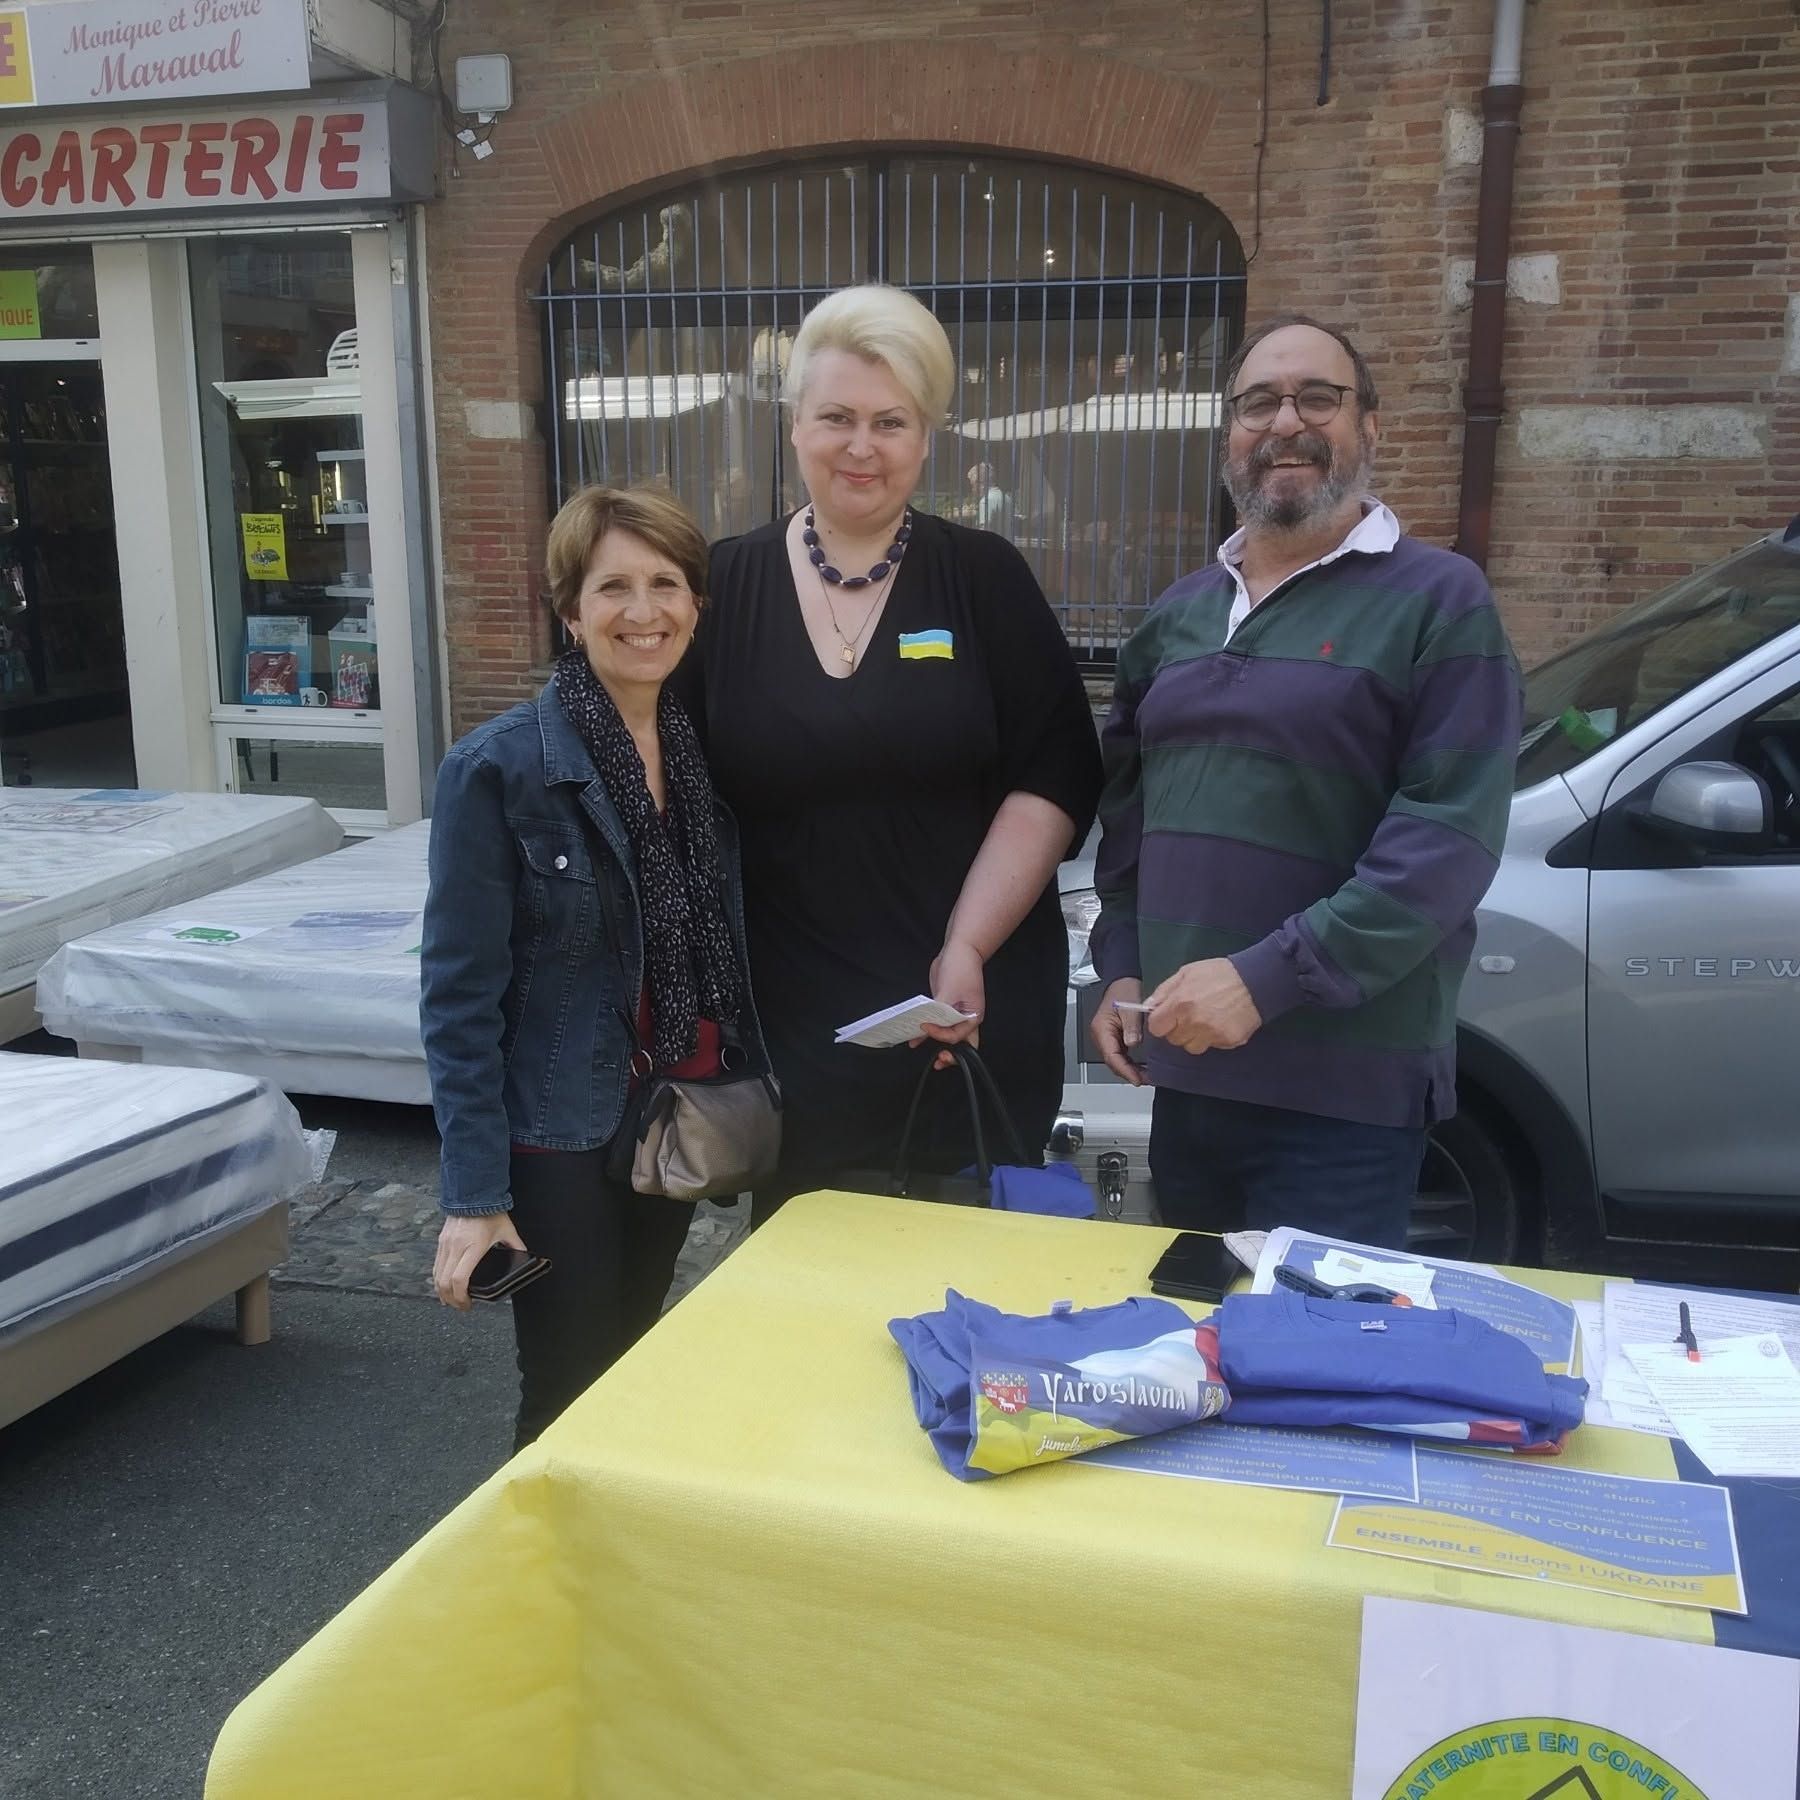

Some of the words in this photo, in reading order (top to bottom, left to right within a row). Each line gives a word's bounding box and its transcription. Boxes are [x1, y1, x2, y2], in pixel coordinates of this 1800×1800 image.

[63, 21, 162, 54] Monique
[168, 8, 187, 33] et
[193, 0, 263, 28] Pierre
[90, 29, 244, 97] Maraval
[1, 113, 365, 208] CARTERIE
[1625, 957, 1800, 978] STEPW
[1039, 1372, 1186, 1424] Yaroslavna
[1603, 1492, 1656, 1505] studio
[1510, 1510, 1541, 1525] EN
[1548, 1519, 1708, 1550] CONFLUENCE
[1356, 1527, 1483, 1556] ENSEMBLE
[1494, 1551, 1572, 1573] aidons
[1579, 1562, 1706, 1593] l'UKRAINE
[1538, 1731, 1579, 1756] EN
[1588, 1741, 1684, 1800] CONFL
